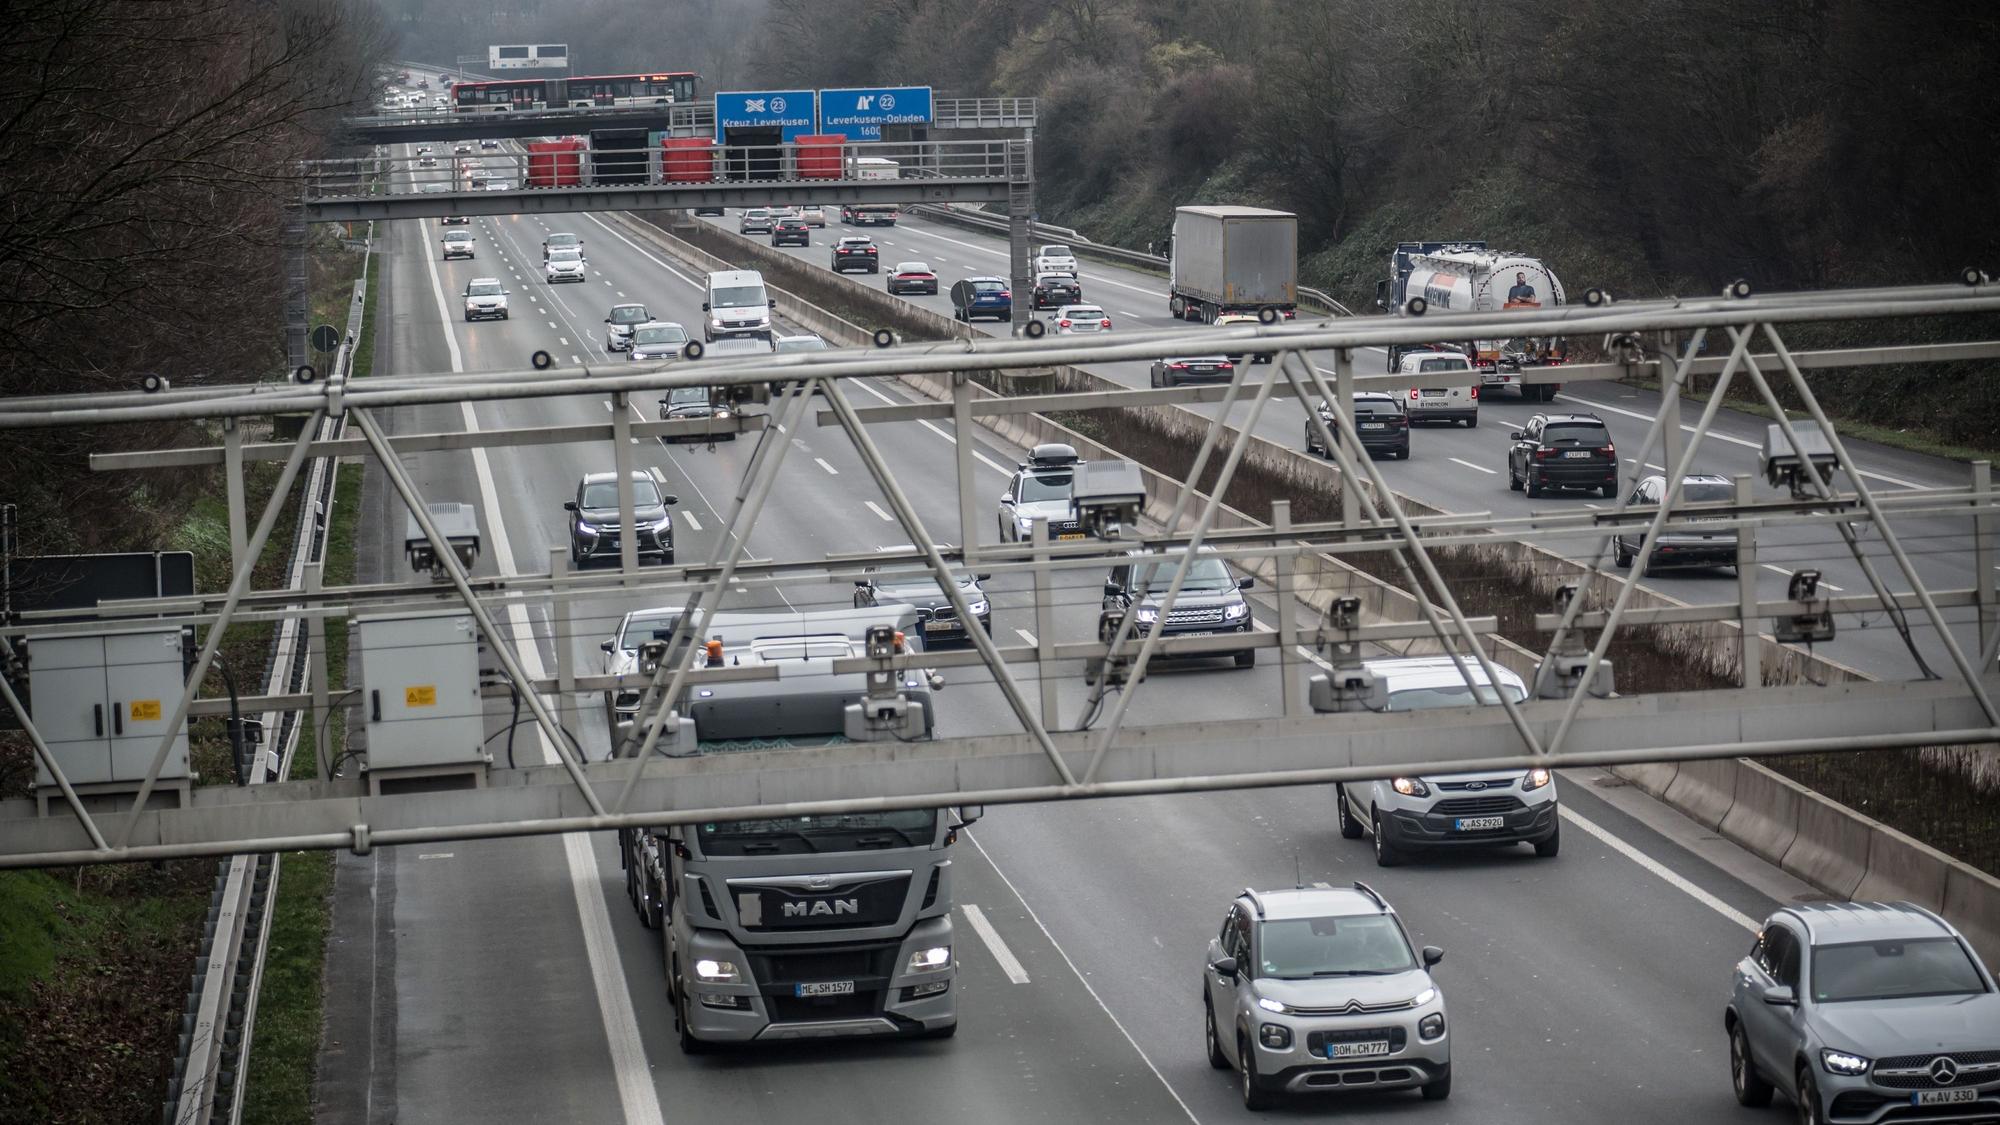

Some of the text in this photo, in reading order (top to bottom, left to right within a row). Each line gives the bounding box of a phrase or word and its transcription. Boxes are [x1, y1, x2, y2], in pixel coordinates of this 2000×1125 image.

[773, 101, 784, 110] 23
[882, 98, 893, 107] 22
[722, 117, 809, 127] Kreuz Leverkusen
[827, 114, 925, 125] Leverkusen-Opladen
[784, 899, 858, 917] MAN
